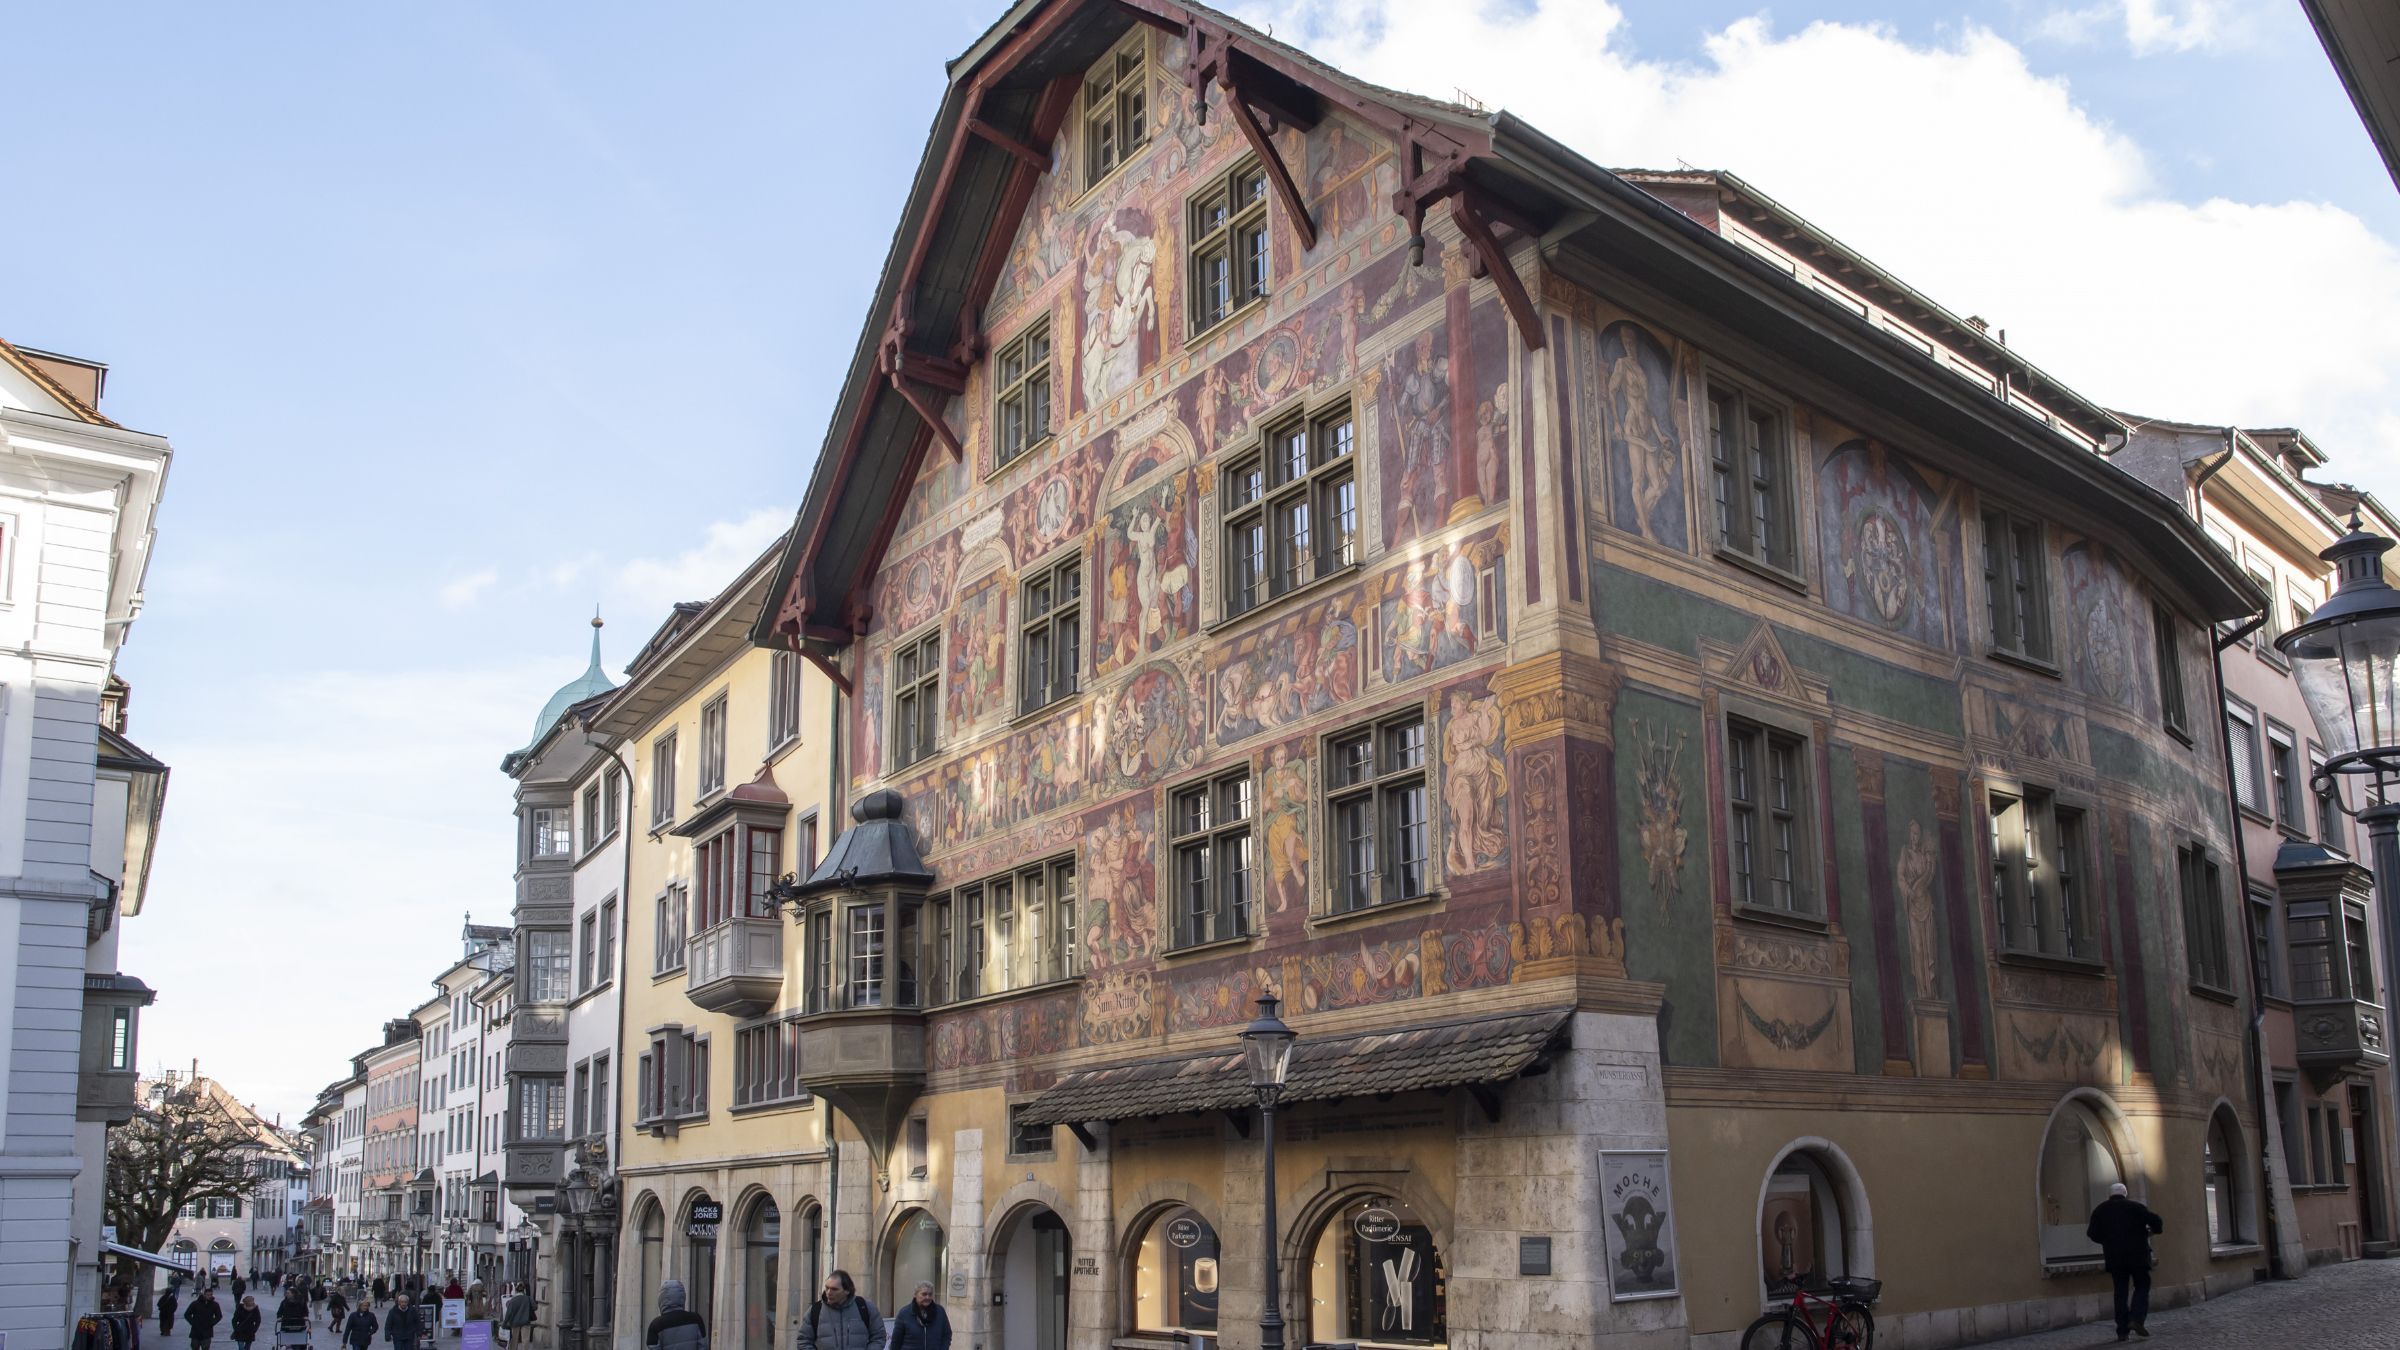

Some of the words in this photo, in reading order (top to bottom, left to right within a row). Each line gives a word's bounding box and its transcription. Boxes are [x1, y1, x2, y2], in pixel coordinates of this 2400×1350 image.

[1114, 992, 1138, 1010] Ritter
[1613, 1173, 1660, 1198] MOCHE
[1369, 1214, 1385, 1223] Ritter
[1361, 1225, 1393, 1233] Parfümerie
[1388, 1234, 1412, 1242] SENSAI
[1078, 1258, 1096, 1267] RITTER
[1073, 1266, 1100, 1276] APOTHEKE
